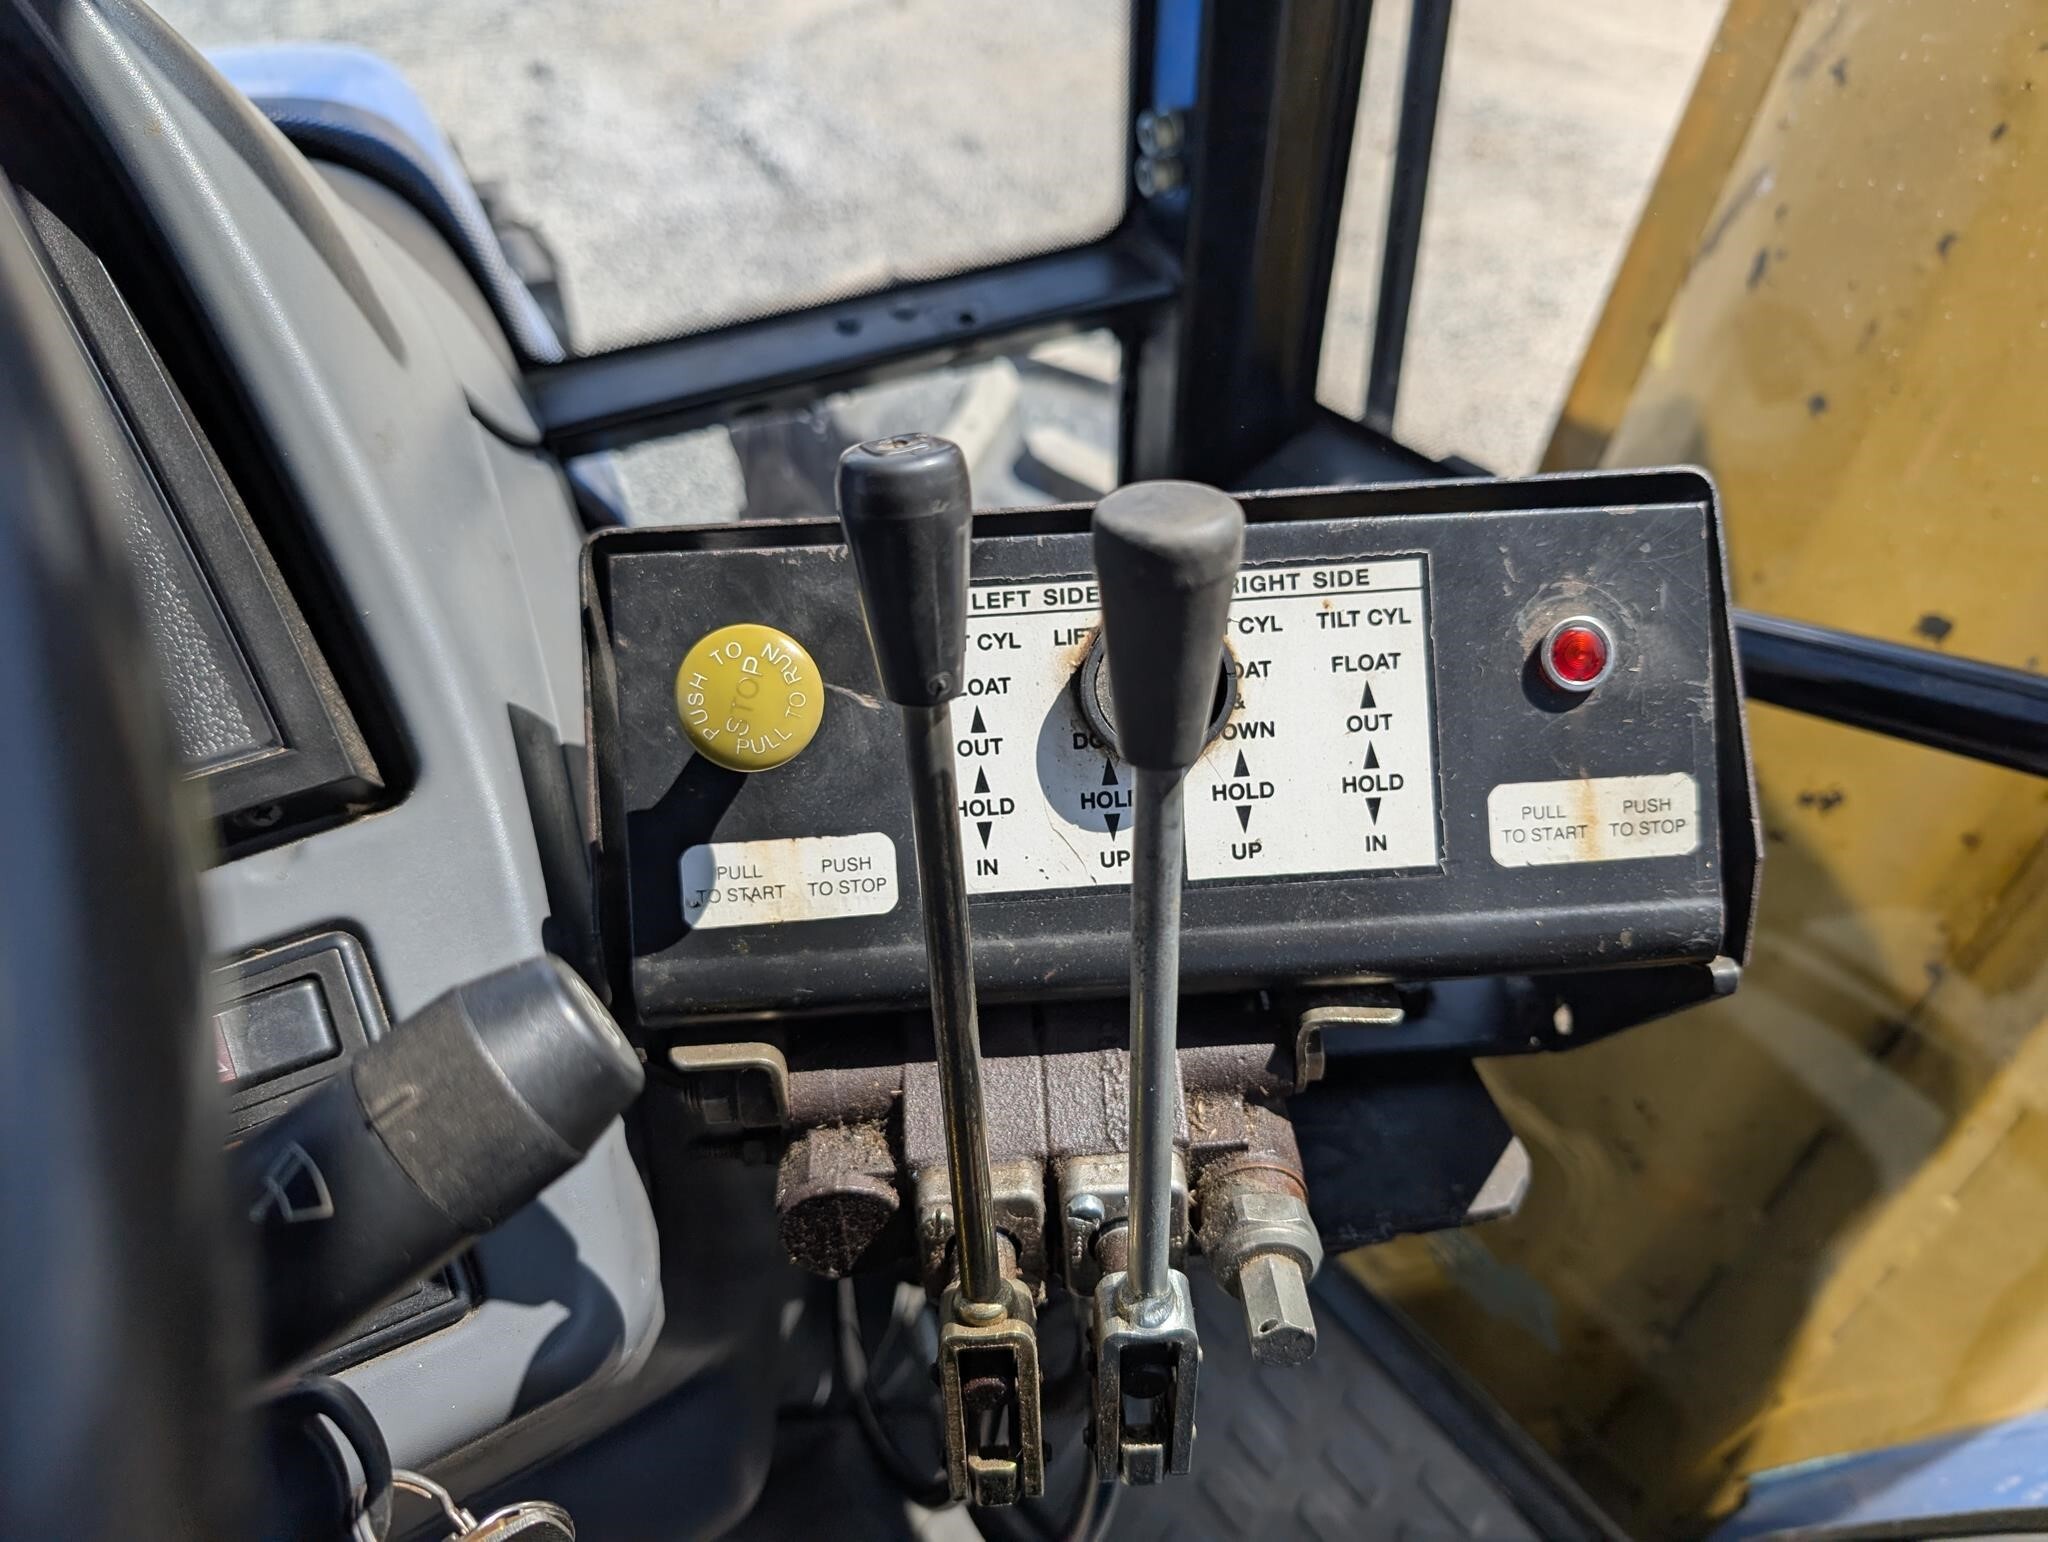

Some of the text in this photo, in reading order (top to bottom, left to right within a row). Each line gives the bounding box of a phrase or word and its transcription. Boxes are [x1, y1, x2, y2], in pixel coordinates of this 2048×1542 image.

[1313, 568, 1370, 588] SIDE
[972, 586, 1100, 610] LEFT SIDE
[1238, 615, 1283, 635] CYL
[1316, 607, 1411, 630] TILT CYL
[977, 632, 1022, 651] CYL
[1054, 627, 1093, 647] LIF
[1331, 652, 1401, 673] FLOAT
[687, 641, 742, 741] PUSH TO
[726, 656, 763, 736] STOP
[961, 676, 1011, 696] OAT
[736, 643, 806, 754] PULL TO RUN
[1222, 721, 1275, 740] OWN
[1346, 713, 1393, 733] OUT
[957, 737, 1003, 757] OUT
[1211, 782, 1275, 801] HOLD
[1342, 774, 1404, 794] HOLD
[1521, 804, 1567, 820] PULL
[1623, 798, 1671, 814] PUSH
[1502, 824, 1588, 844] TO START
[1609, 818, 1686, 837] TO STOP
[1231, 842, 1262, 860] UP
[1365, 834, 1387, 852] IN
[821, 856, 872, 873] PUSH
[977, 859, 998, 876] IN
[1100, 850, 1131, 868] UP
[717, 864, 763, 880] PULL
[696, 884, 786, 904] TO START
[808, 877, 887, 896] TO STOP
